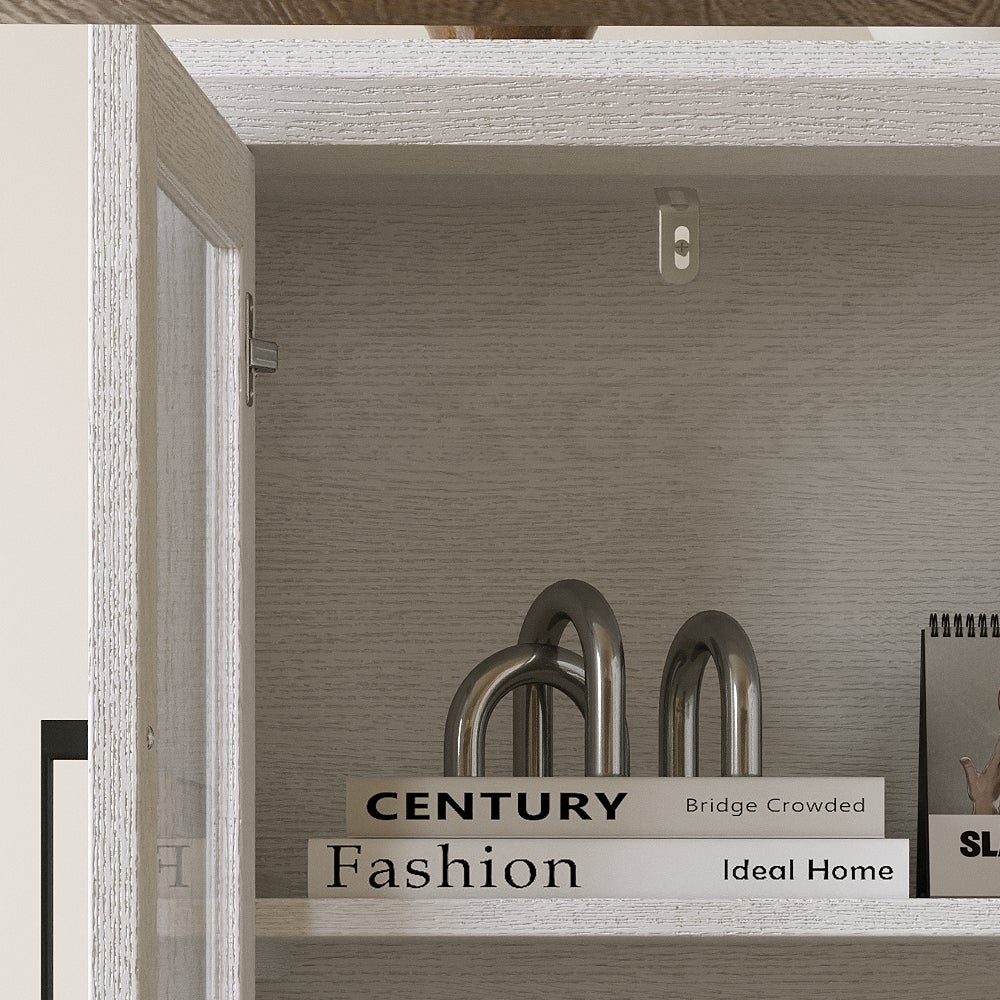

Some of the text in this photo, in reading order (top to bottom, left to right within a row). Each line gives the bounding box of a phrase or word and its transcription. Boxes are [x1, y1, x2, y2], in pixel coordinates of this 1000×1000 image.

[366, 792, 628, 821] CENTURY
[686, 797, 866, 817] Bridge Crowded
[326, 843, 582, 889] Fashion
[724, 858, 894, 881] Ideal Home
